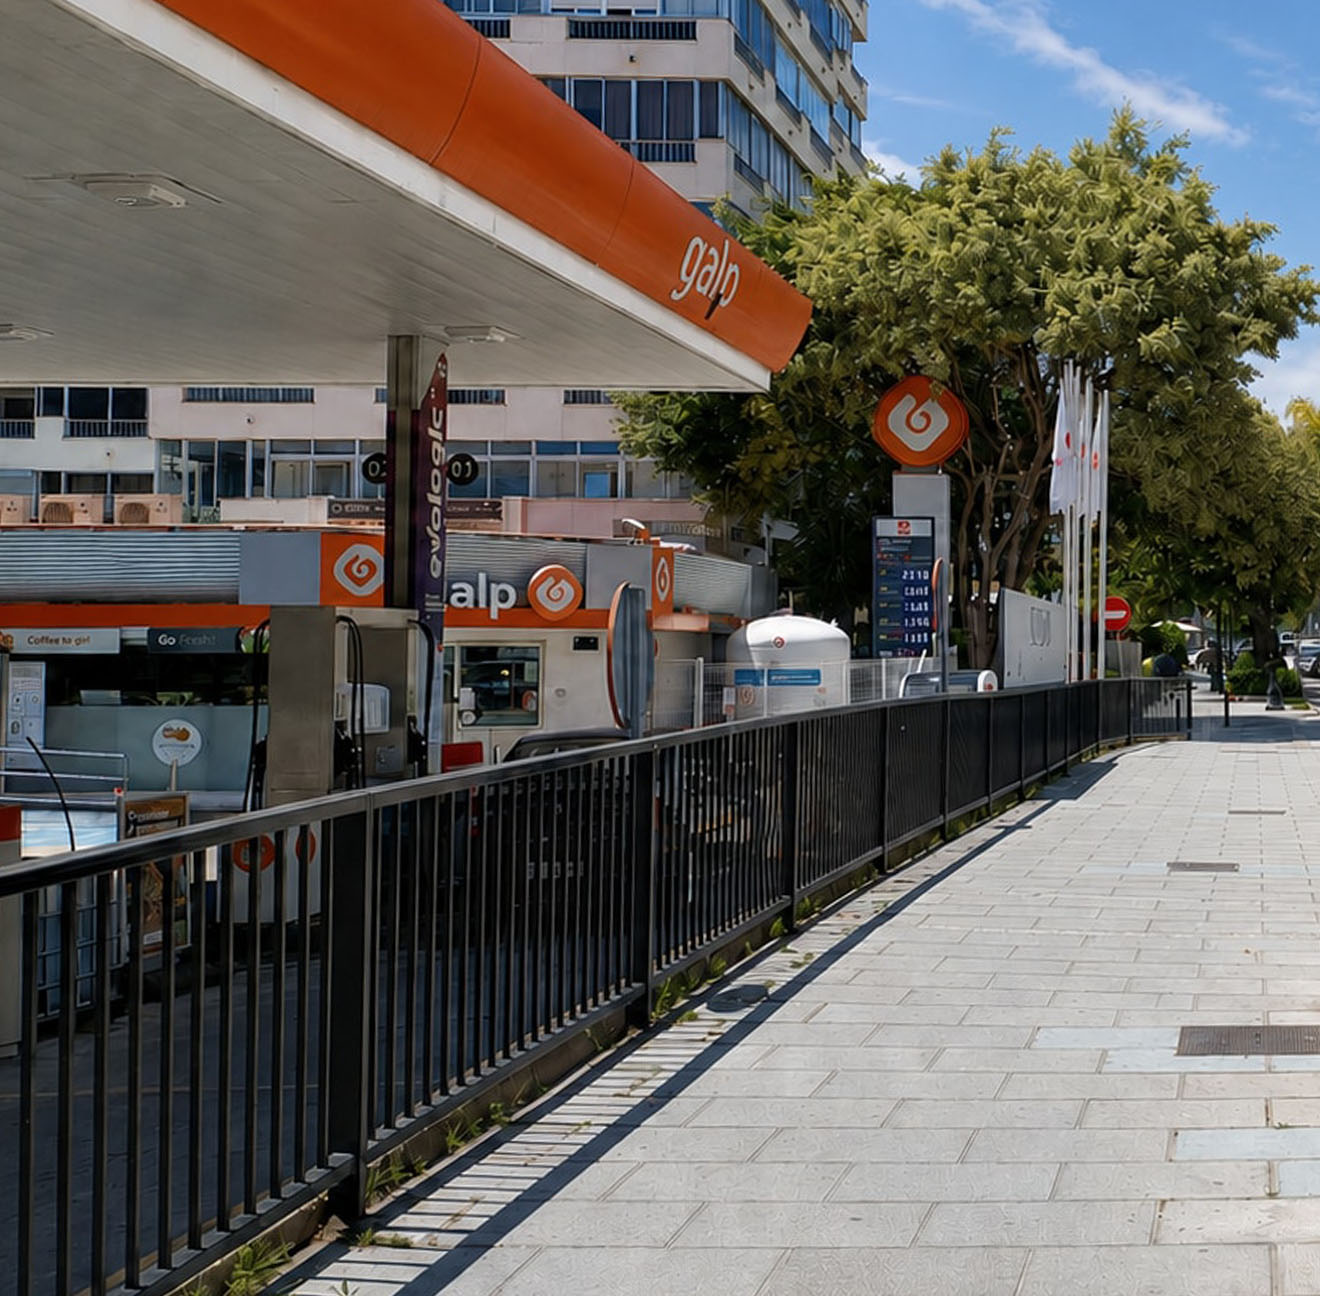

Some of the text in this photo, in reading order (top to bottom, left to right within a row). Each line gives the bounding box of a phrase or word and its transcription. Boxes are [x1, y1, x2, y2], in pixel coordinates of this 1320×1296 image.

[670, 236, 740, 320] galp
[451, 572, 516, 620] alp
[158, 634, 176, 646] Go
